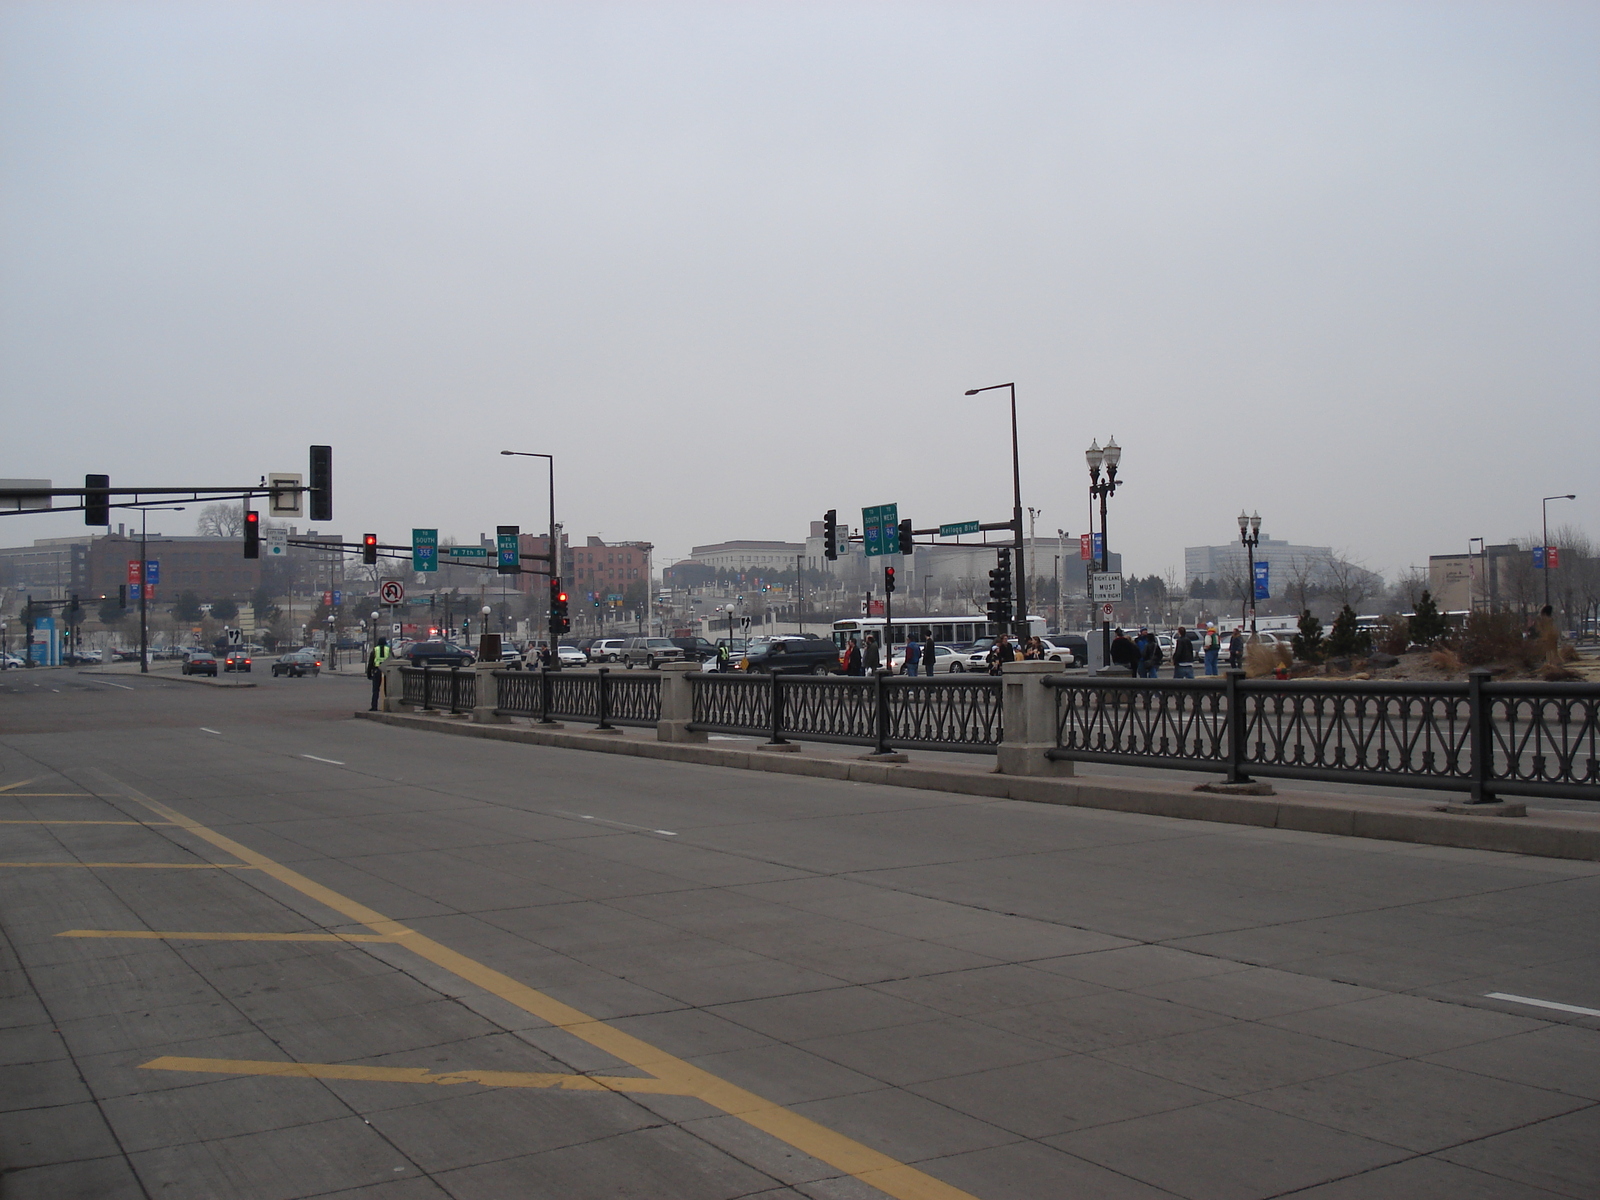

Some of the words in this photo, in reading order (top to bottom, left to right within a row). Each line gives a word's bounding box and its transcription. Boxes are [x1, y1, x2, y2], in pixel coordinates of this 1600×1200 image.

[865, 516, 879, 524] SOUTH
[885, 528, 893, 536] 94
[941, 527, 963, 535] Kellogg
[964, 524, 978, 532] Blvd
[868, 530, 877, 539] 35E
